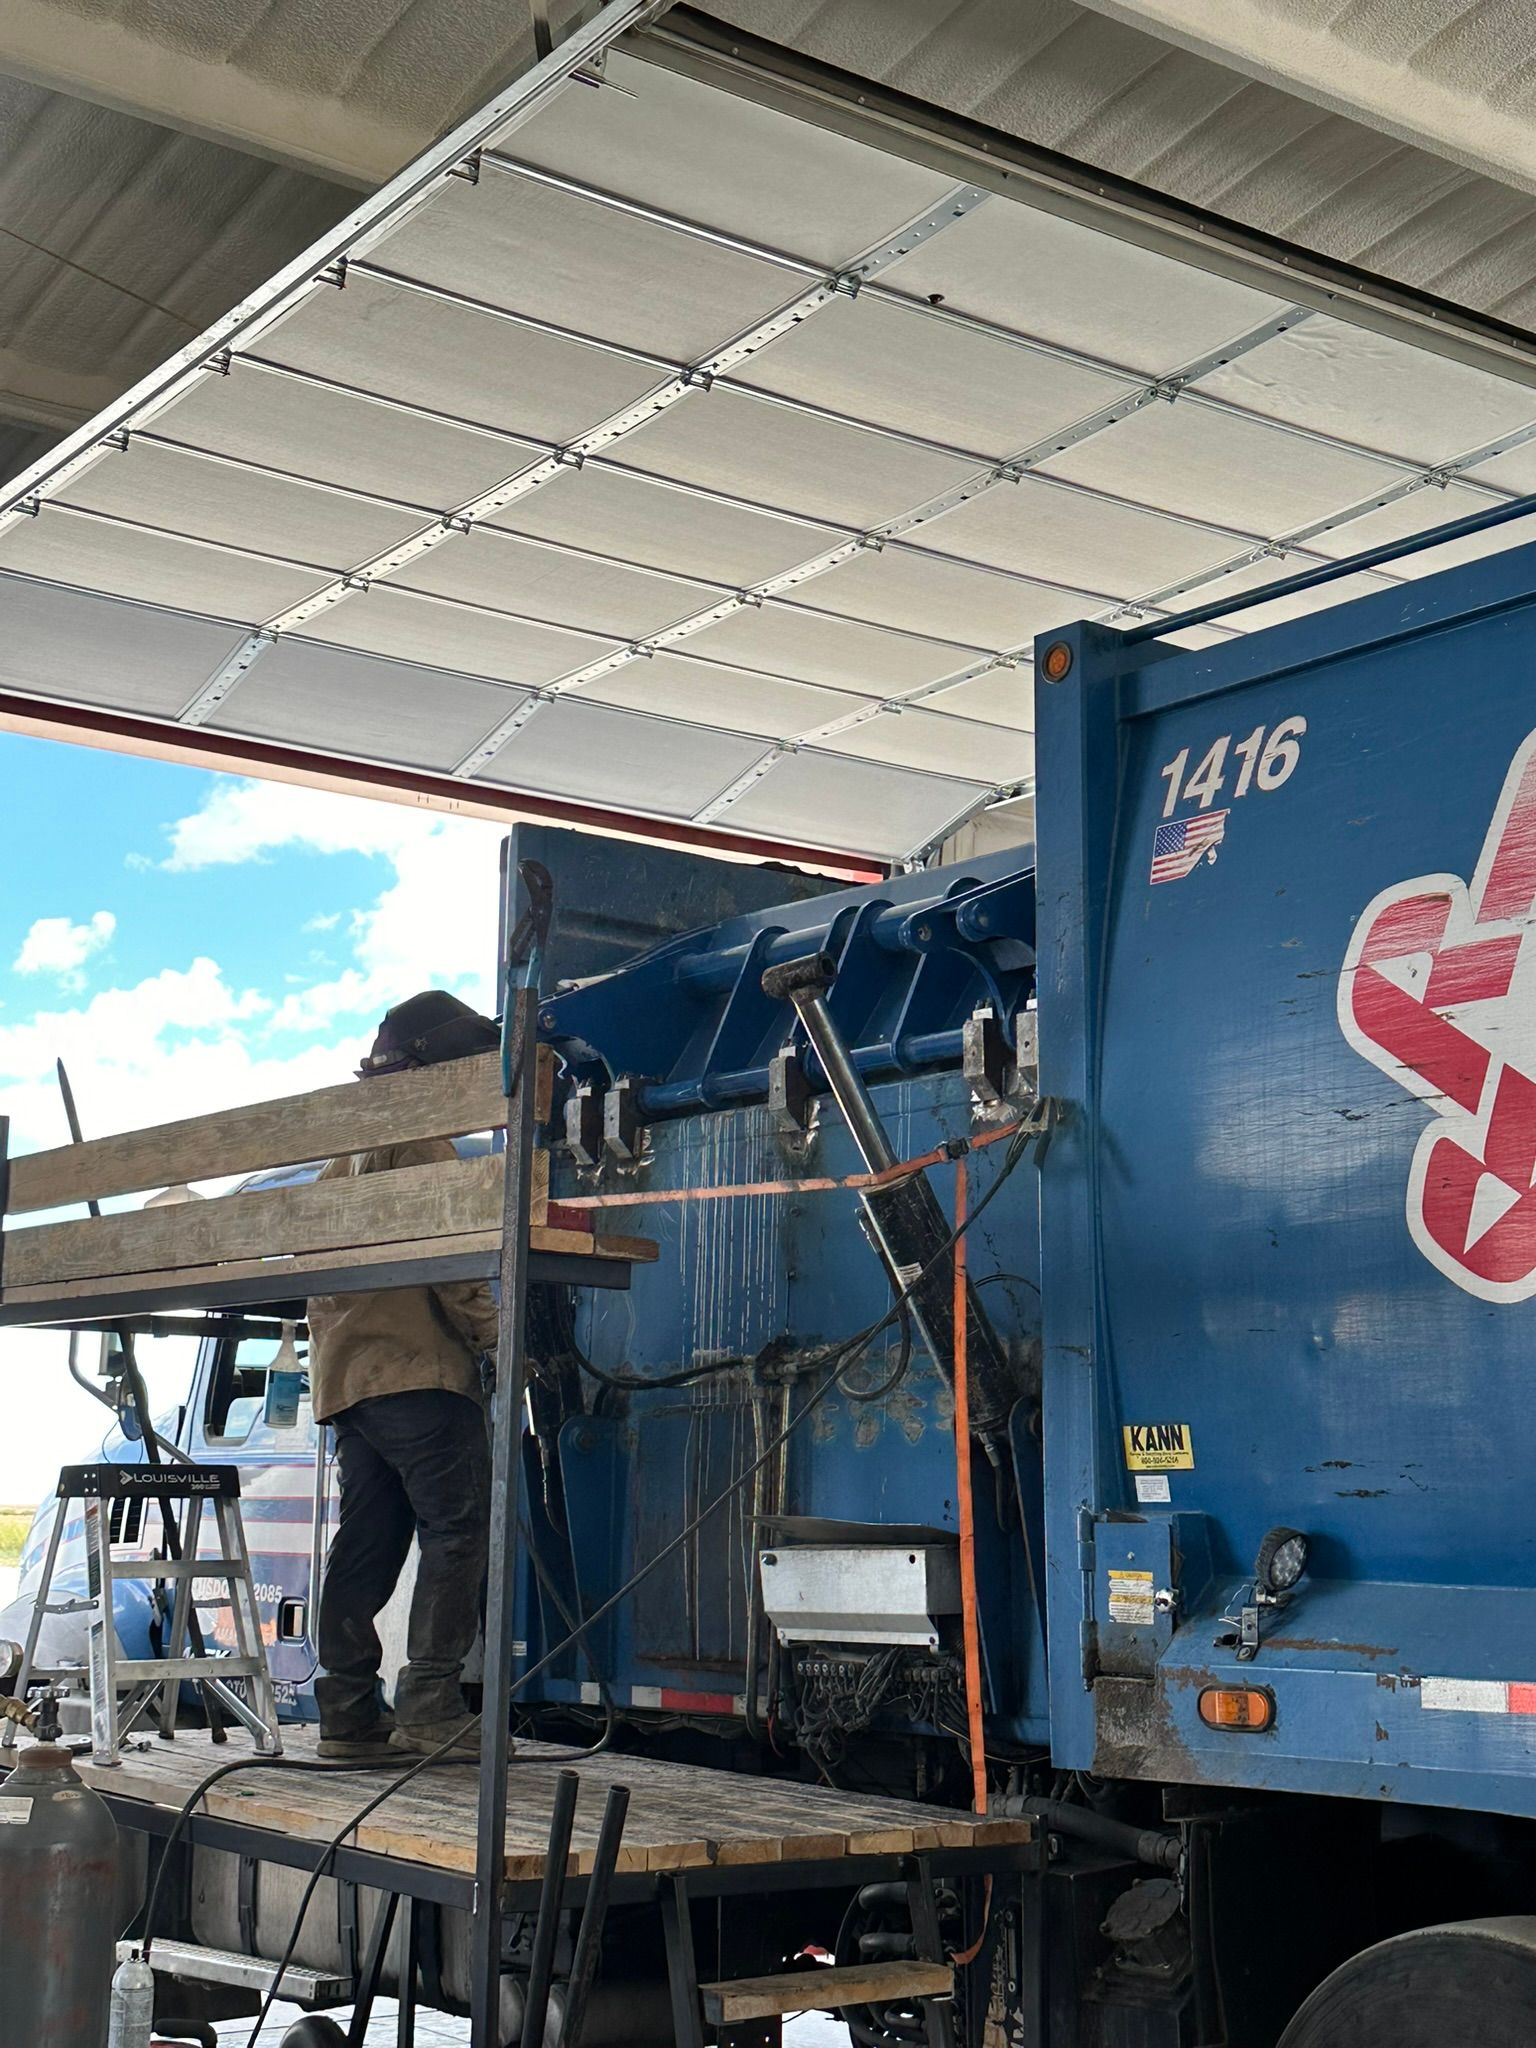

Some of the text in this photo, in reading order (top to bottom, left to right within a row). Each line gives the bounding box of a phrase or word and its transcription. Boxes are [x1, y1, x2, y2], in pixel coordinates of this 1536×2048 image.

[1161, 715, 1307, 818] 1416
[1130, 1425, 1185, 1451] KANN
[133, 1473, 220, 1484] LOUISVILLE
